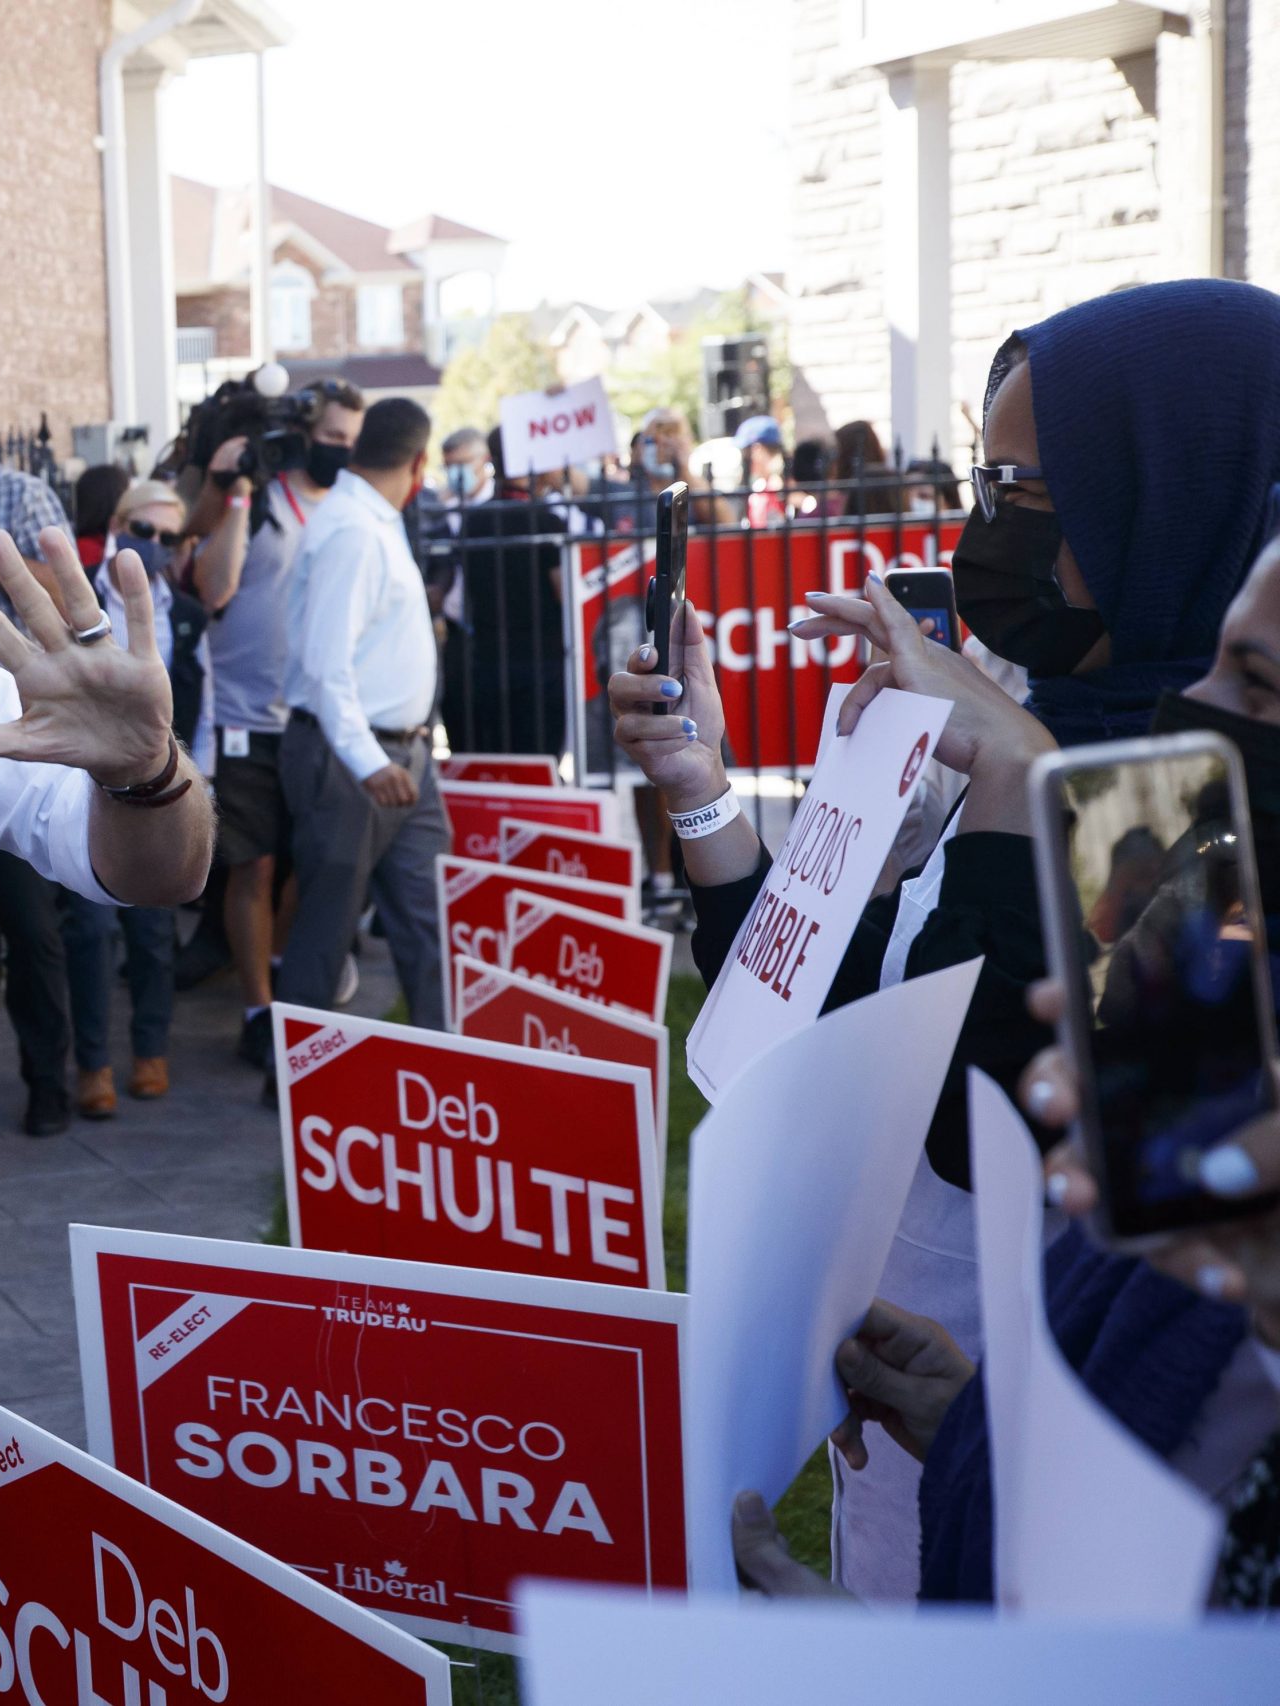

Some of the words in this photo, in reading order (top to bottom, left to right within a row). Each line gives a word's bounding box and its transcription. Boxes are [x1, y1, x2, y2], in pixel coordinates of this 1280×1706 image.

[528, 404, 596, 438] NOW
[558, 934, 604, 987] Deb
[736, 888, 821, 1002] SEMBLE
[288, 1028, 347, 1074] Re-Elect
[396, 1069, 500, 1147] Deb
[300, 1114, 640, 1275] SCHULTE
[321, 1306, 427, 1332] TRUDEAU
[338, 1295, 393, 1313] TEAM
[148, 1305, 212, 1361] RE-ELECT
[207, 1375, 566, 1462] FRANCESCO
[173, 1421, 615, 1545] SORBARA
[333, 1561, 449, 1607] Libéral
[91, 1530, 230, 1703] Deb
